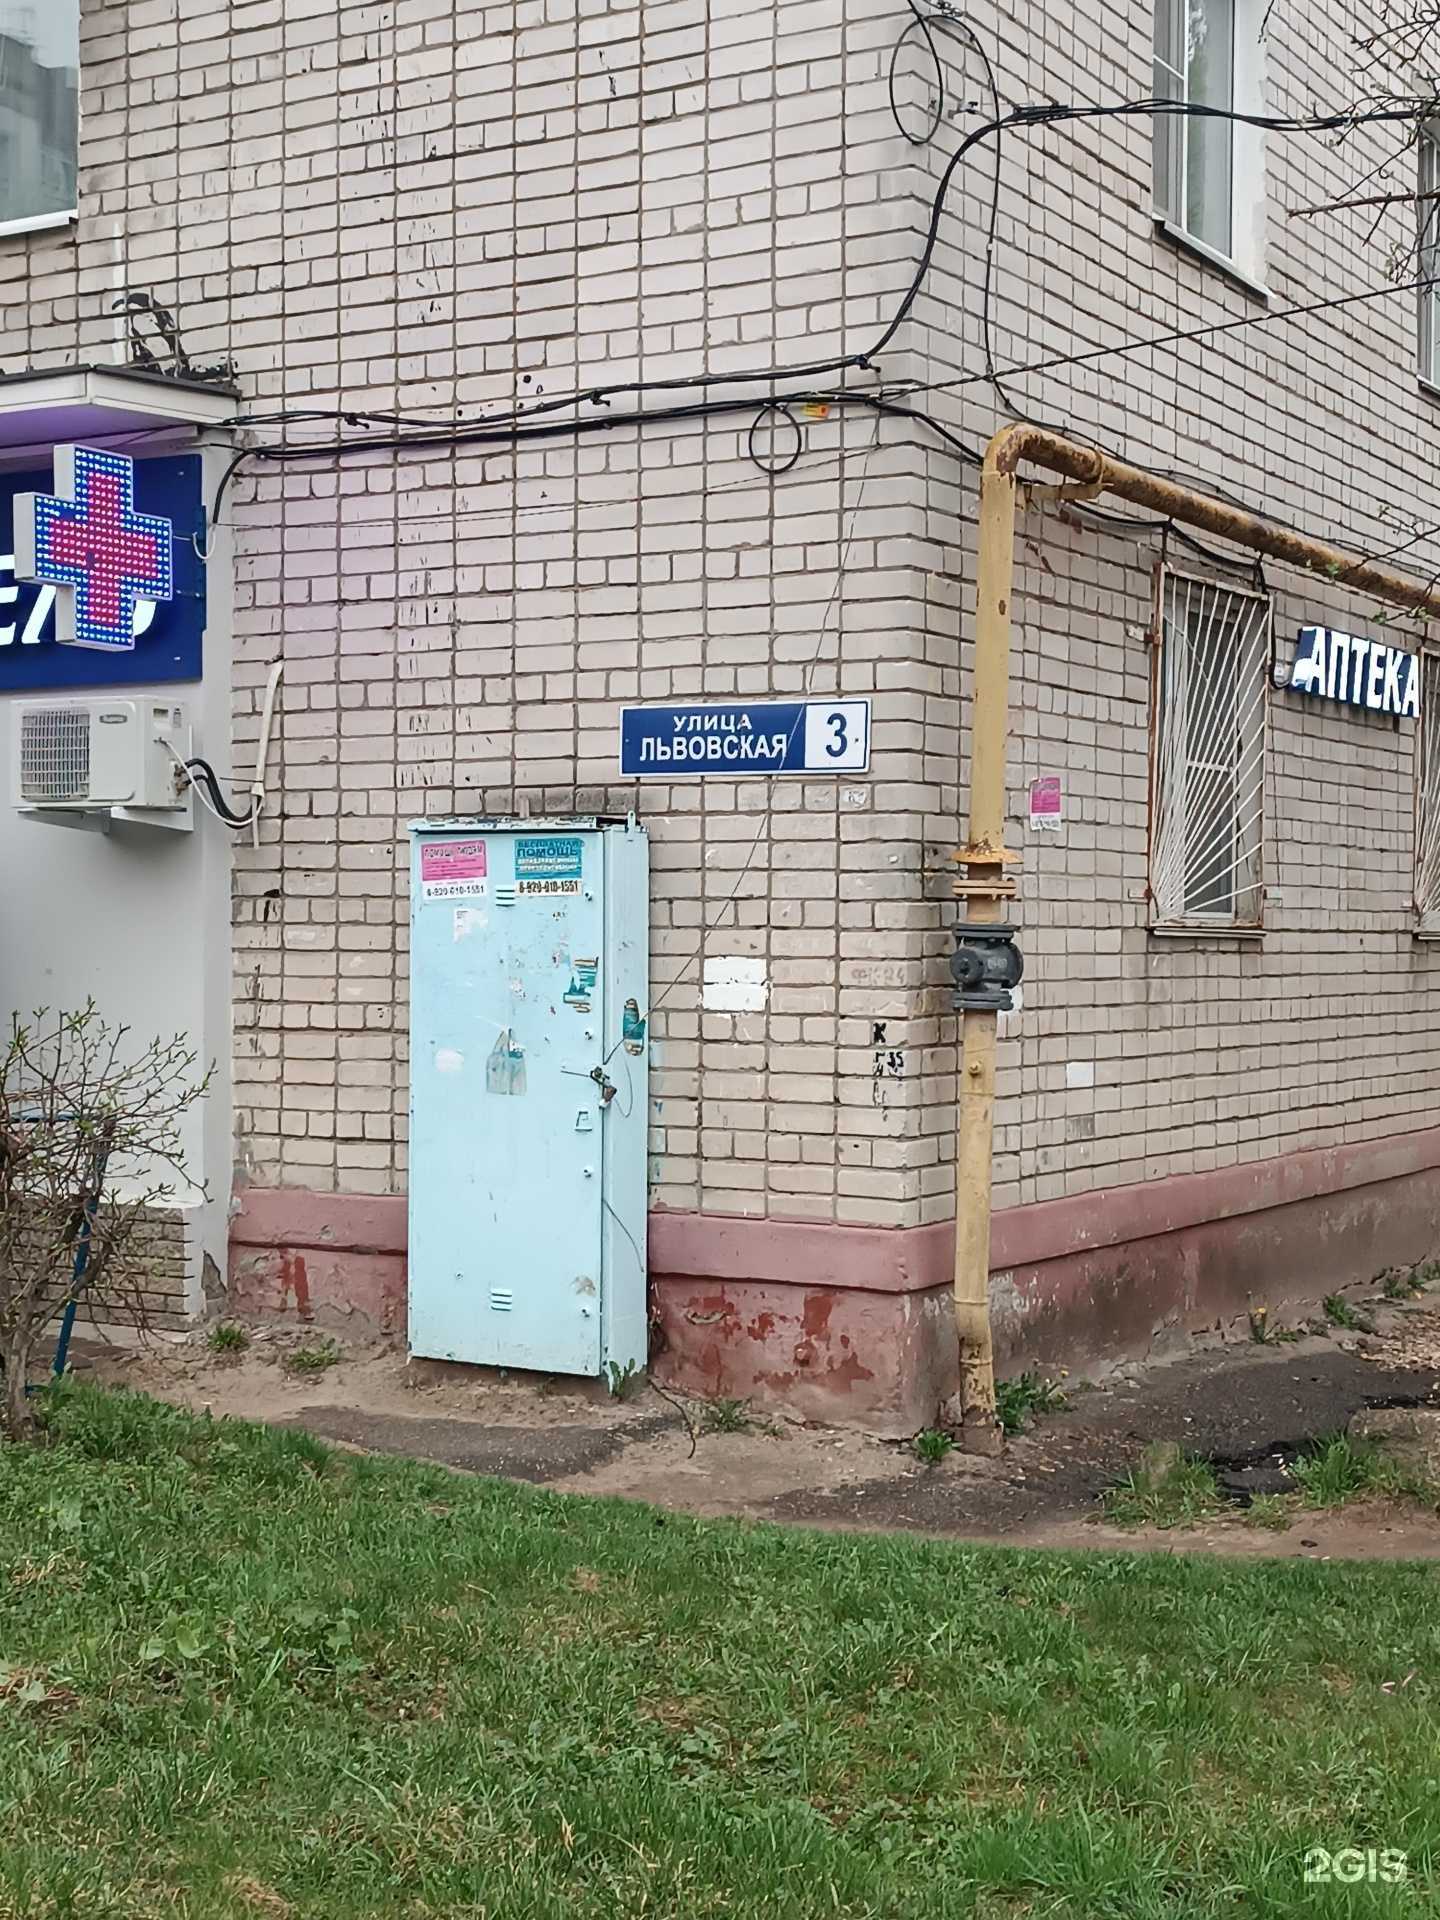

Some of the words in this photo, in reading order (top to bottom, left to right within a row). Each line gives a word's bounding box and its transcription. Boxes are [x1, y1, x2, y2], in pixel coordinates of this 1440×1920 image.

[1305, 626, 1420, 718] АПТЕКА
[639, 733, 787, 762] ЛЬВОВСКАЯ
[825, 712, 848, 758] 3
[673, 713, 752, 734] УЛИЦА
[517, 847, 578, 858] ПОМОЩЬ
